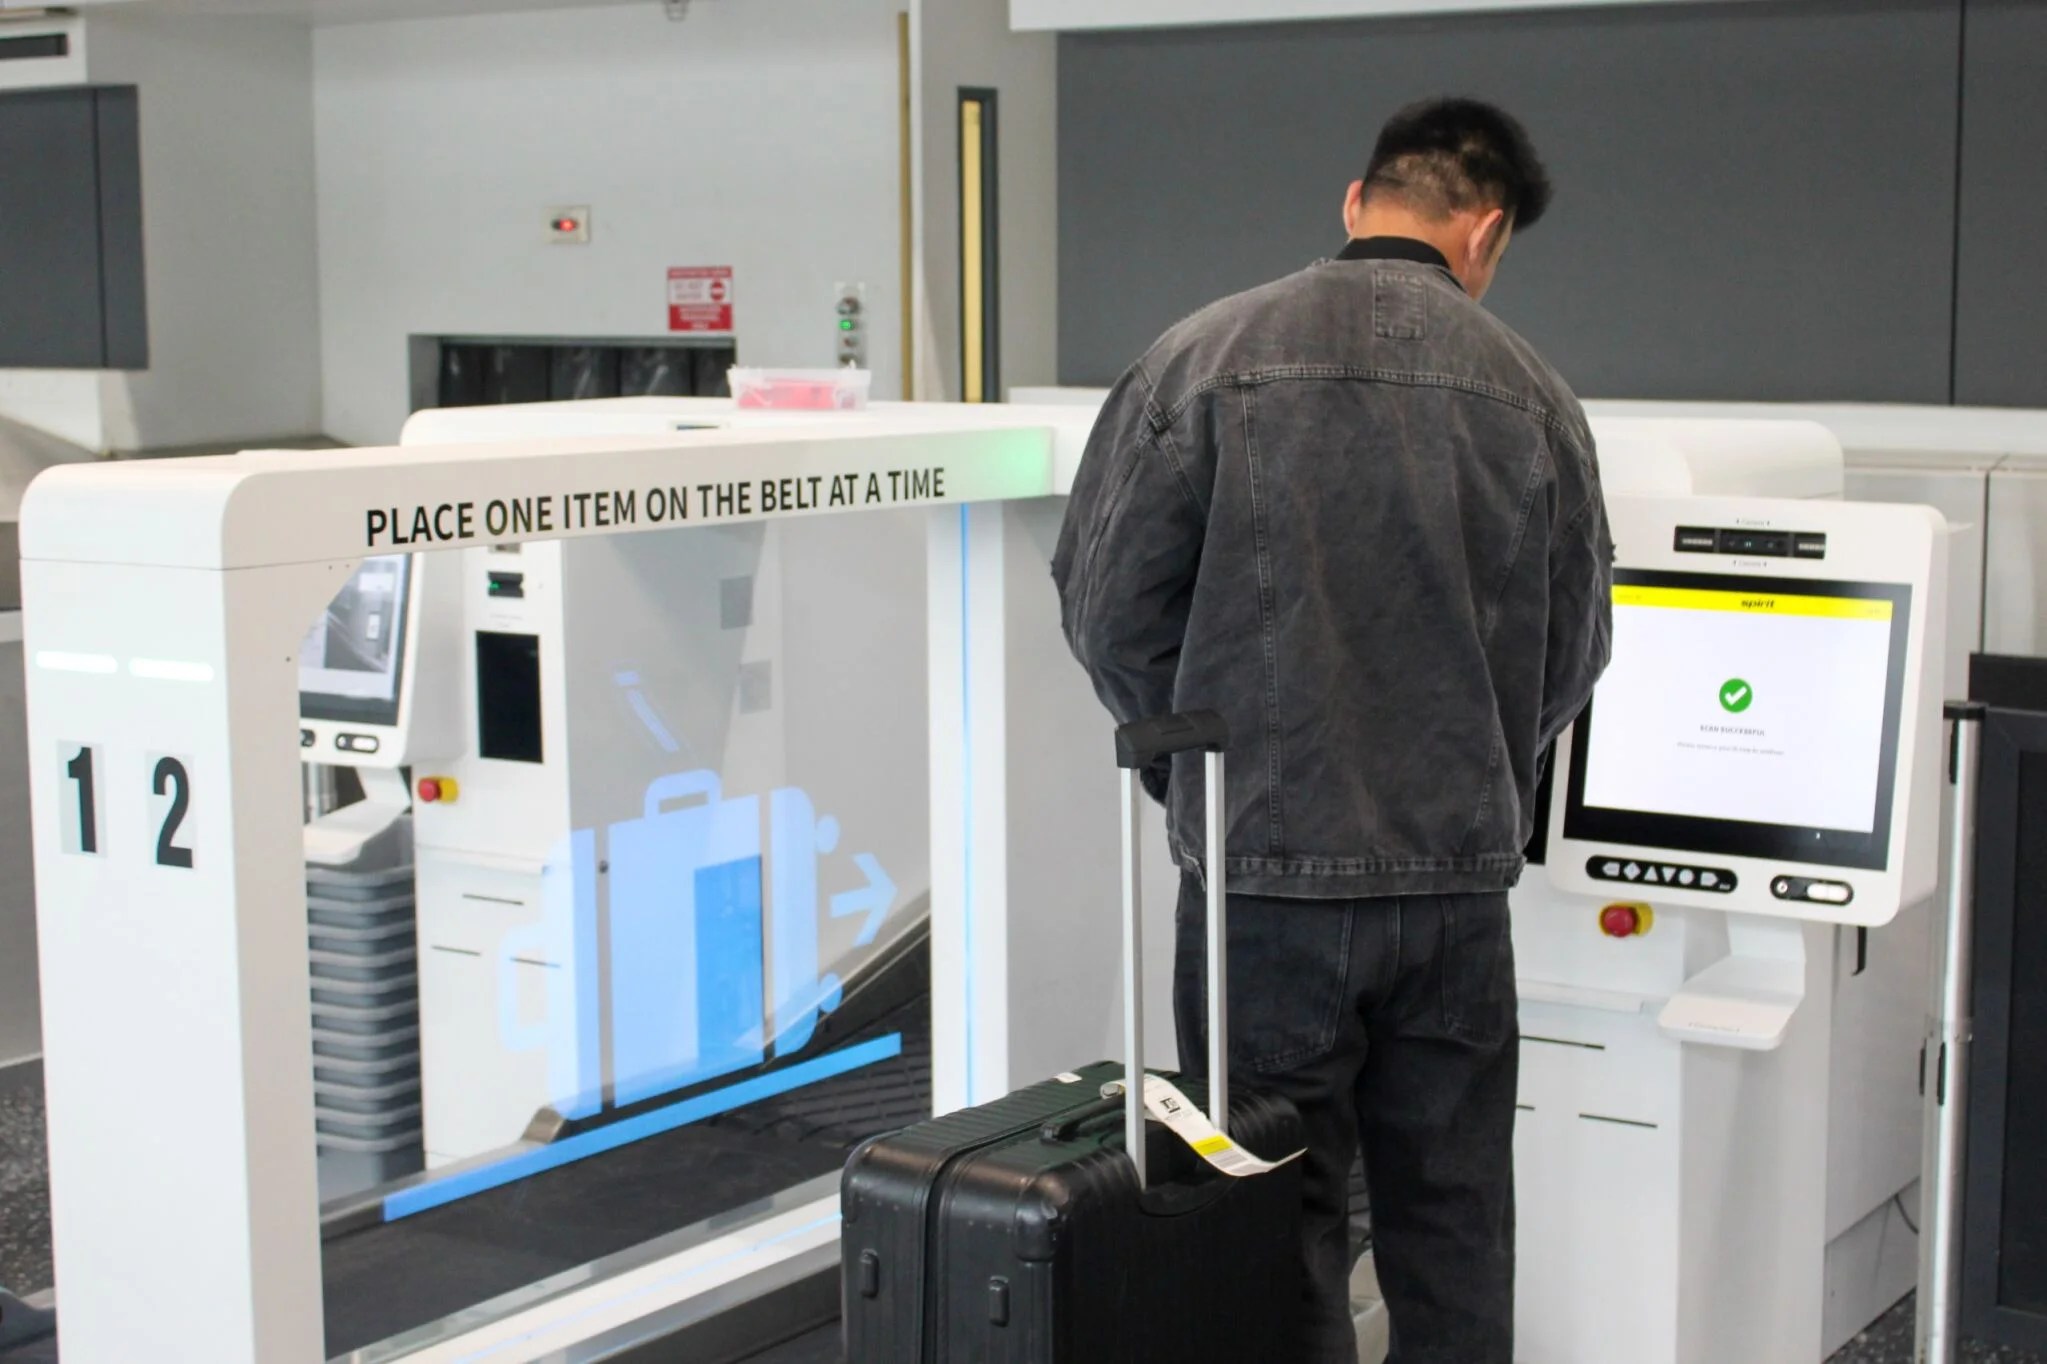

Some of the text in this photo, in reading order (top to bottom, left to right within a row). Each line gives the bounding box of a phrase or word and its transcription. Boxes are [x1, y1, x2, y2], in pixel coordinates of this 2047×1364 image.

[366, 467, 945, 547] PLACE ONE ITEM ON THE BELT AT A TIME
[67, 746, 97, 853] 1
[153, 756, 193, 868] 2
